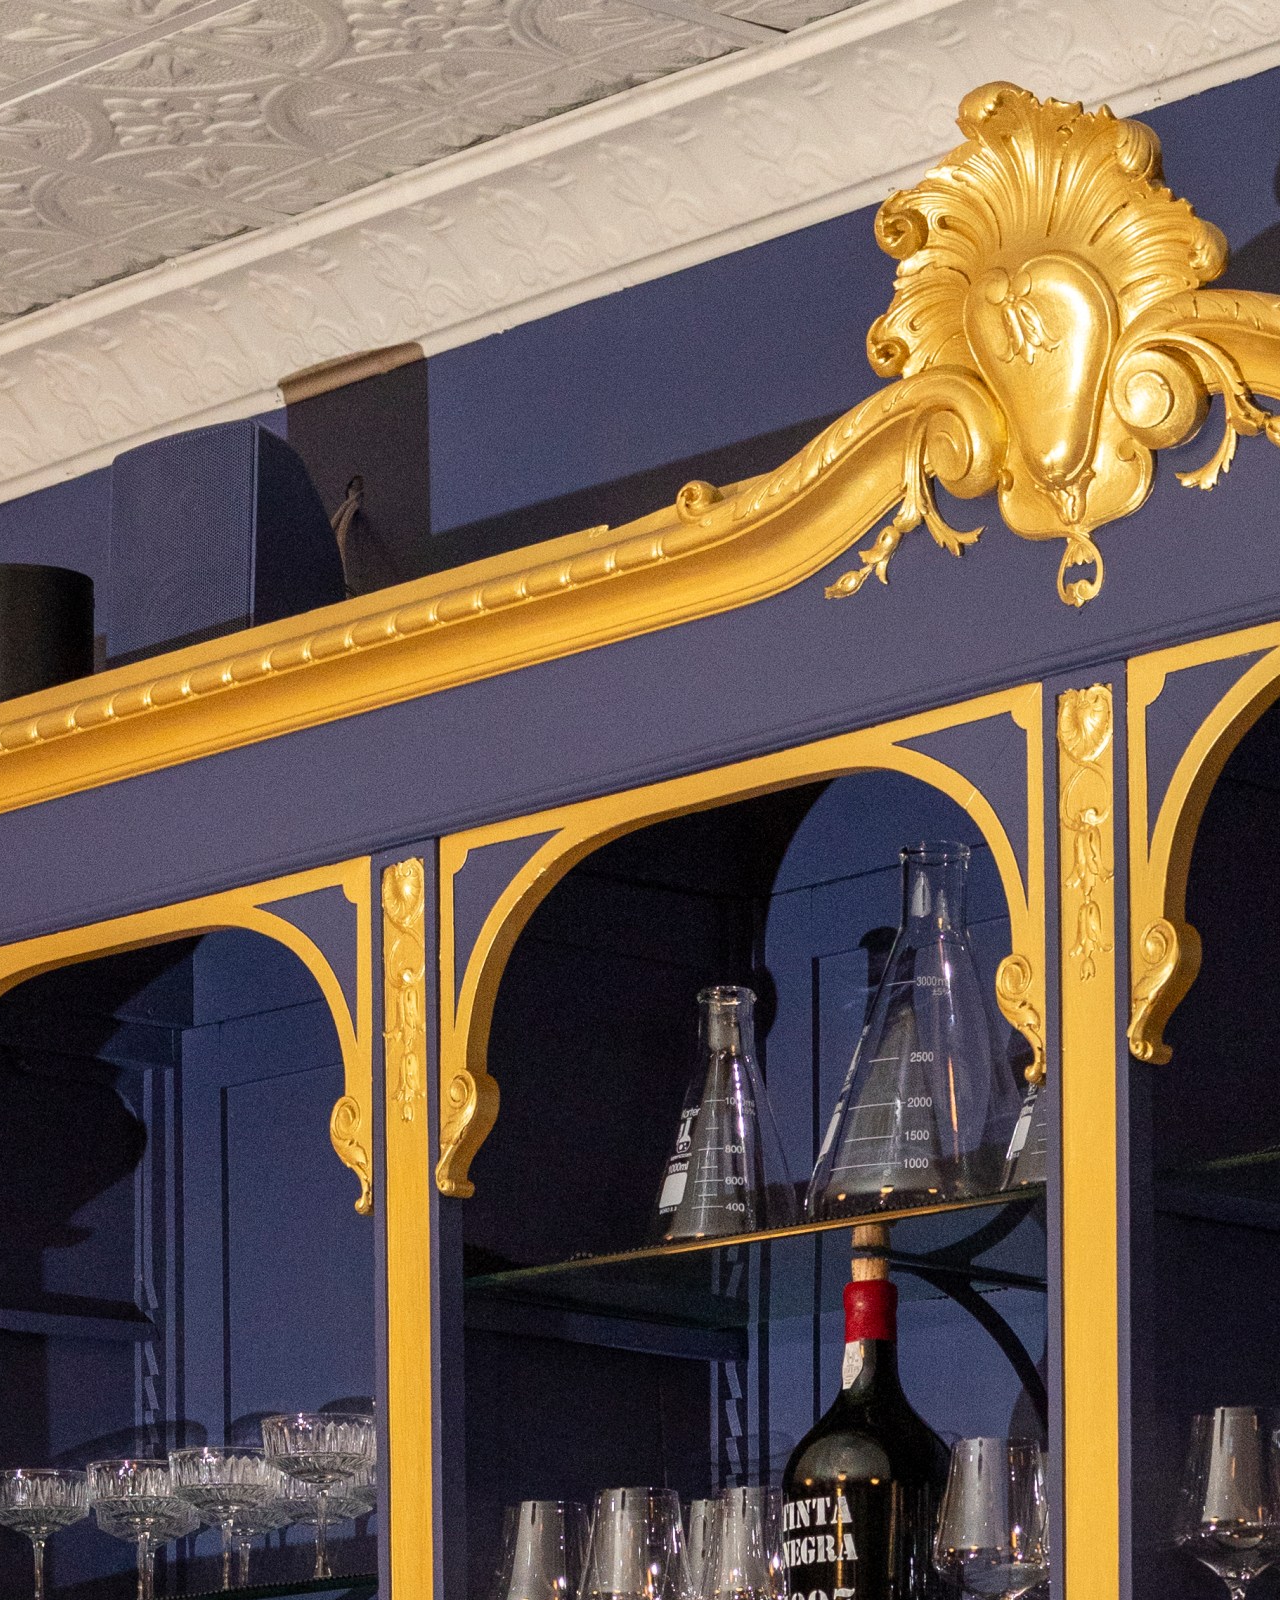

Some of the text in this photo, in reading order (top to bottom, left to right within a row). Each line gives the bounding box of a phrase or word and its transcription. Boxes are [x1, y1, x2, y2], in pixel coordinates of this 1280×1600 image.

[910, 1051, 934, 1063] 2500
[907, 1097, 932, 1107] 2000
[904, 1131, 930, 1141] 1500
[724, 1145, 743, 1154] 800
[903, 1159, 929, 1169] 1000
[725, 1177, 744, 1185] 600
[725, 1203, 745, 1212] 400
